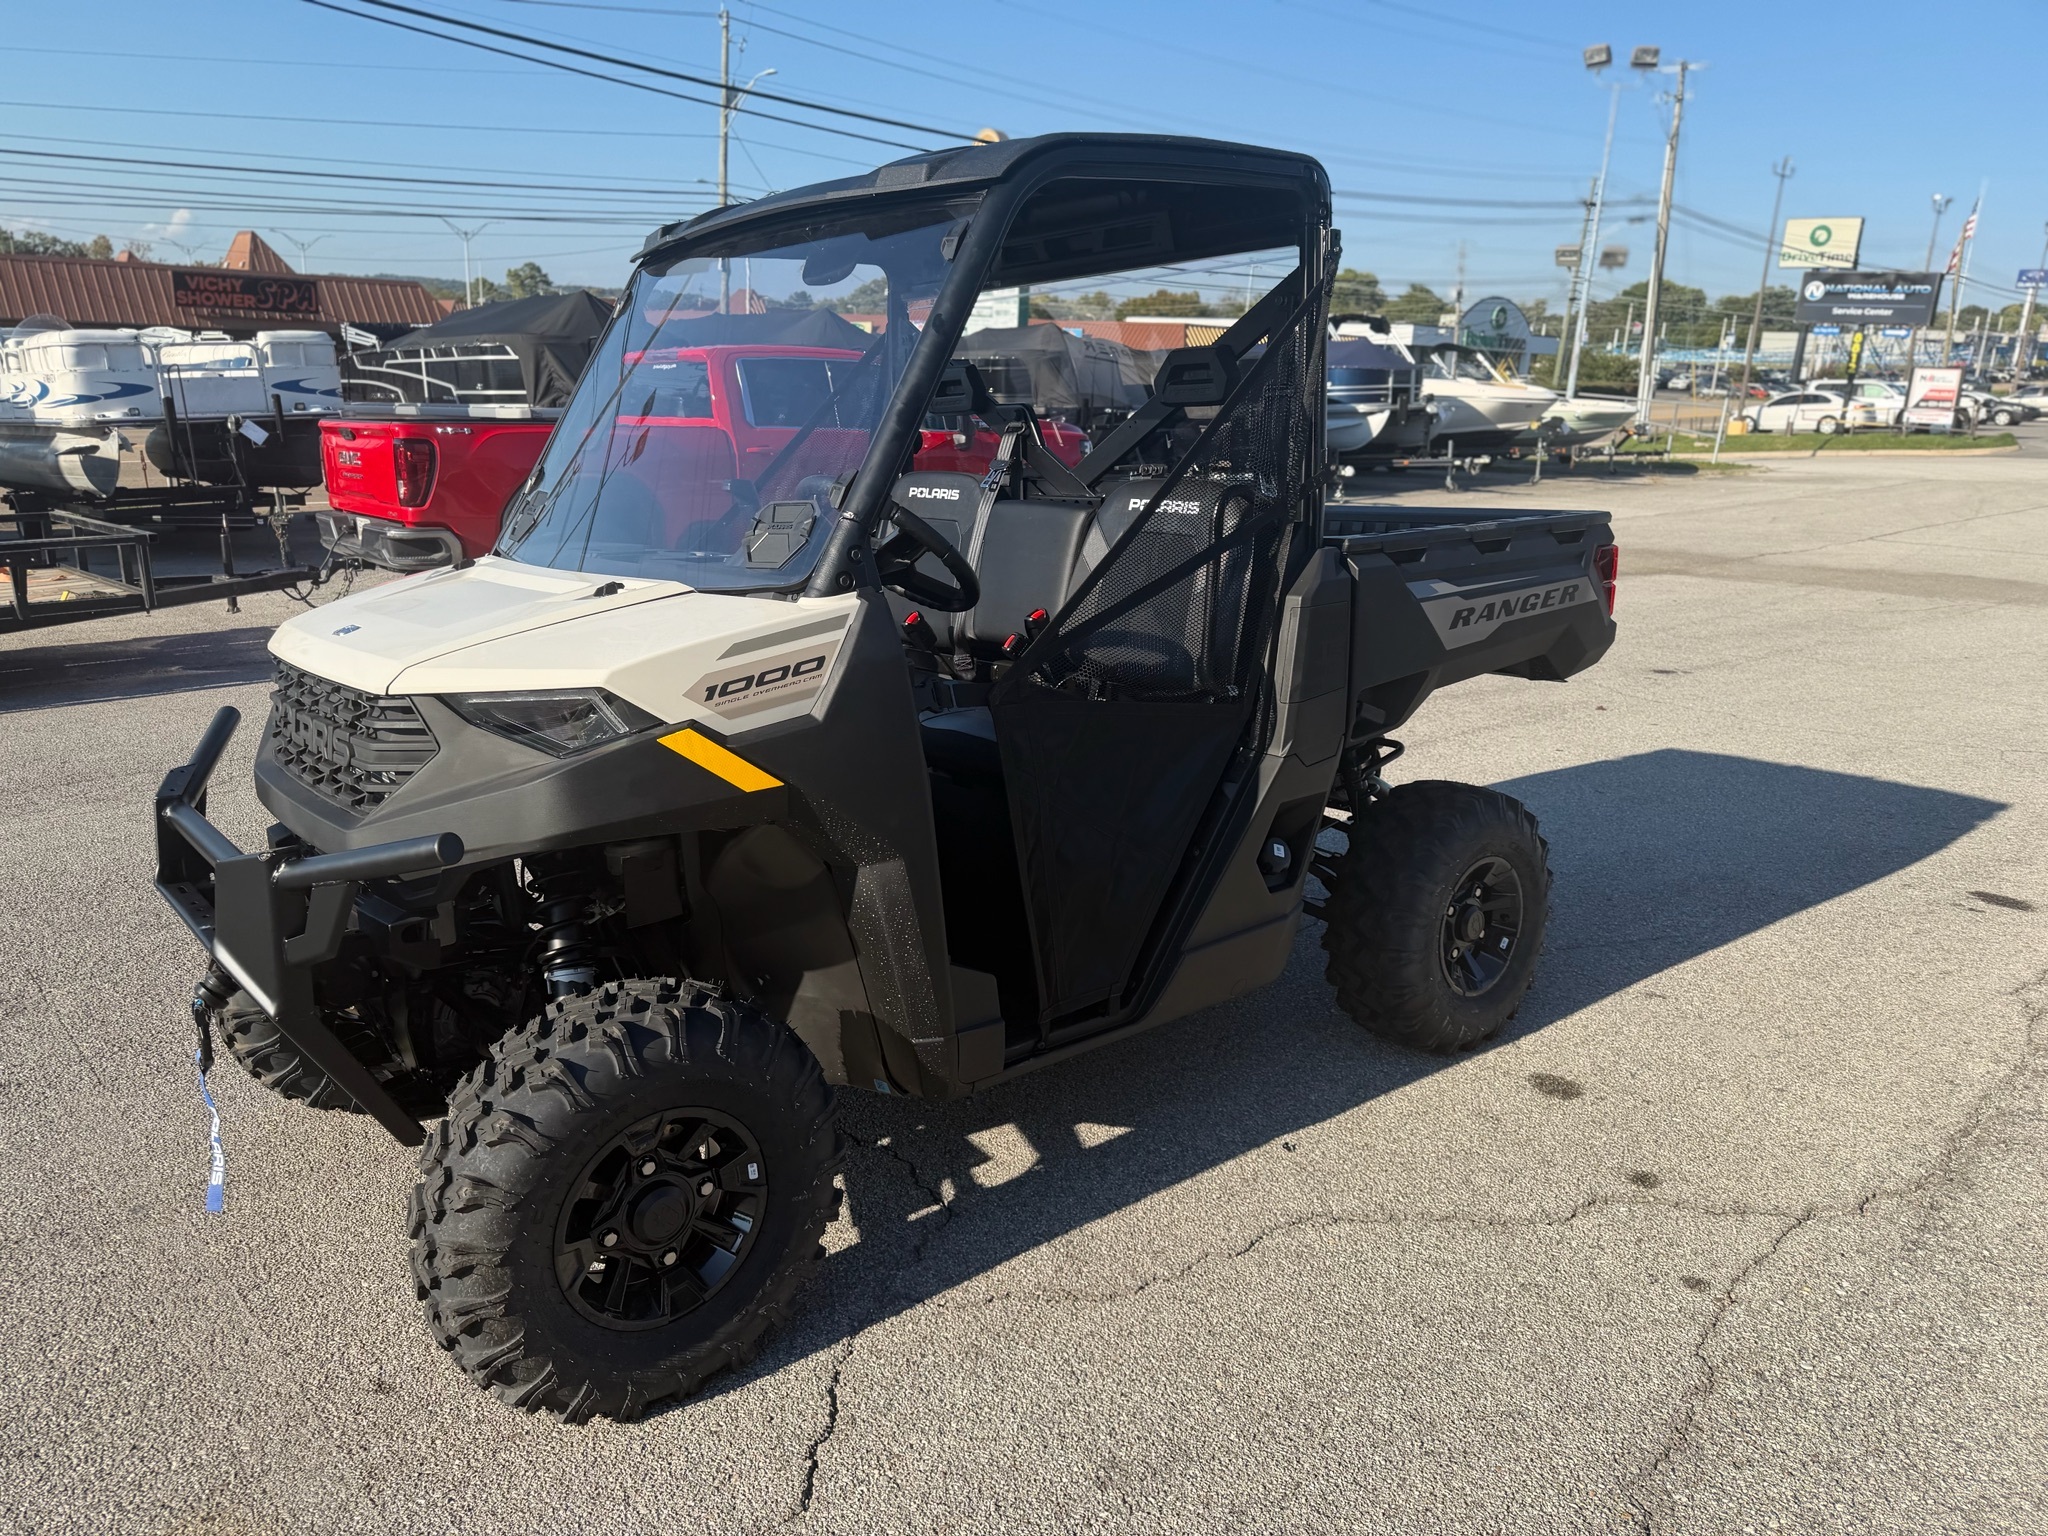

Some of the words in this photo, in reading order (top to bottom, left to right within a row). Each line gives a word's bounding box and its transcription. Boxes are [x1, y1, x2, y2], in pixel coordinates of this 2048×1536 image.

[185, 275, 244, 292] VICHY
[1825, 283, 1889, 293] NATIONAL
[1892, 284, 1932, 294] AUTO
[176, 290, 257, 308] SHOWER
[256, 280, 317, 312] SPA
[1847, 292, 1906, 301] WAREHOUSE
[1832, 306, 1862, 316] Service
[1864, 306, 1894, 316] Center
[908, 486, 960, 501] POLARIS
[1447, 583, 1580, 631] RANGER
[703, 654, 827, 703] 1000
[714, 693, 750, 708] SINGLE
[752, 678, 801, 697] OVERHEAD
[803, 672, 823, 684] CAM
